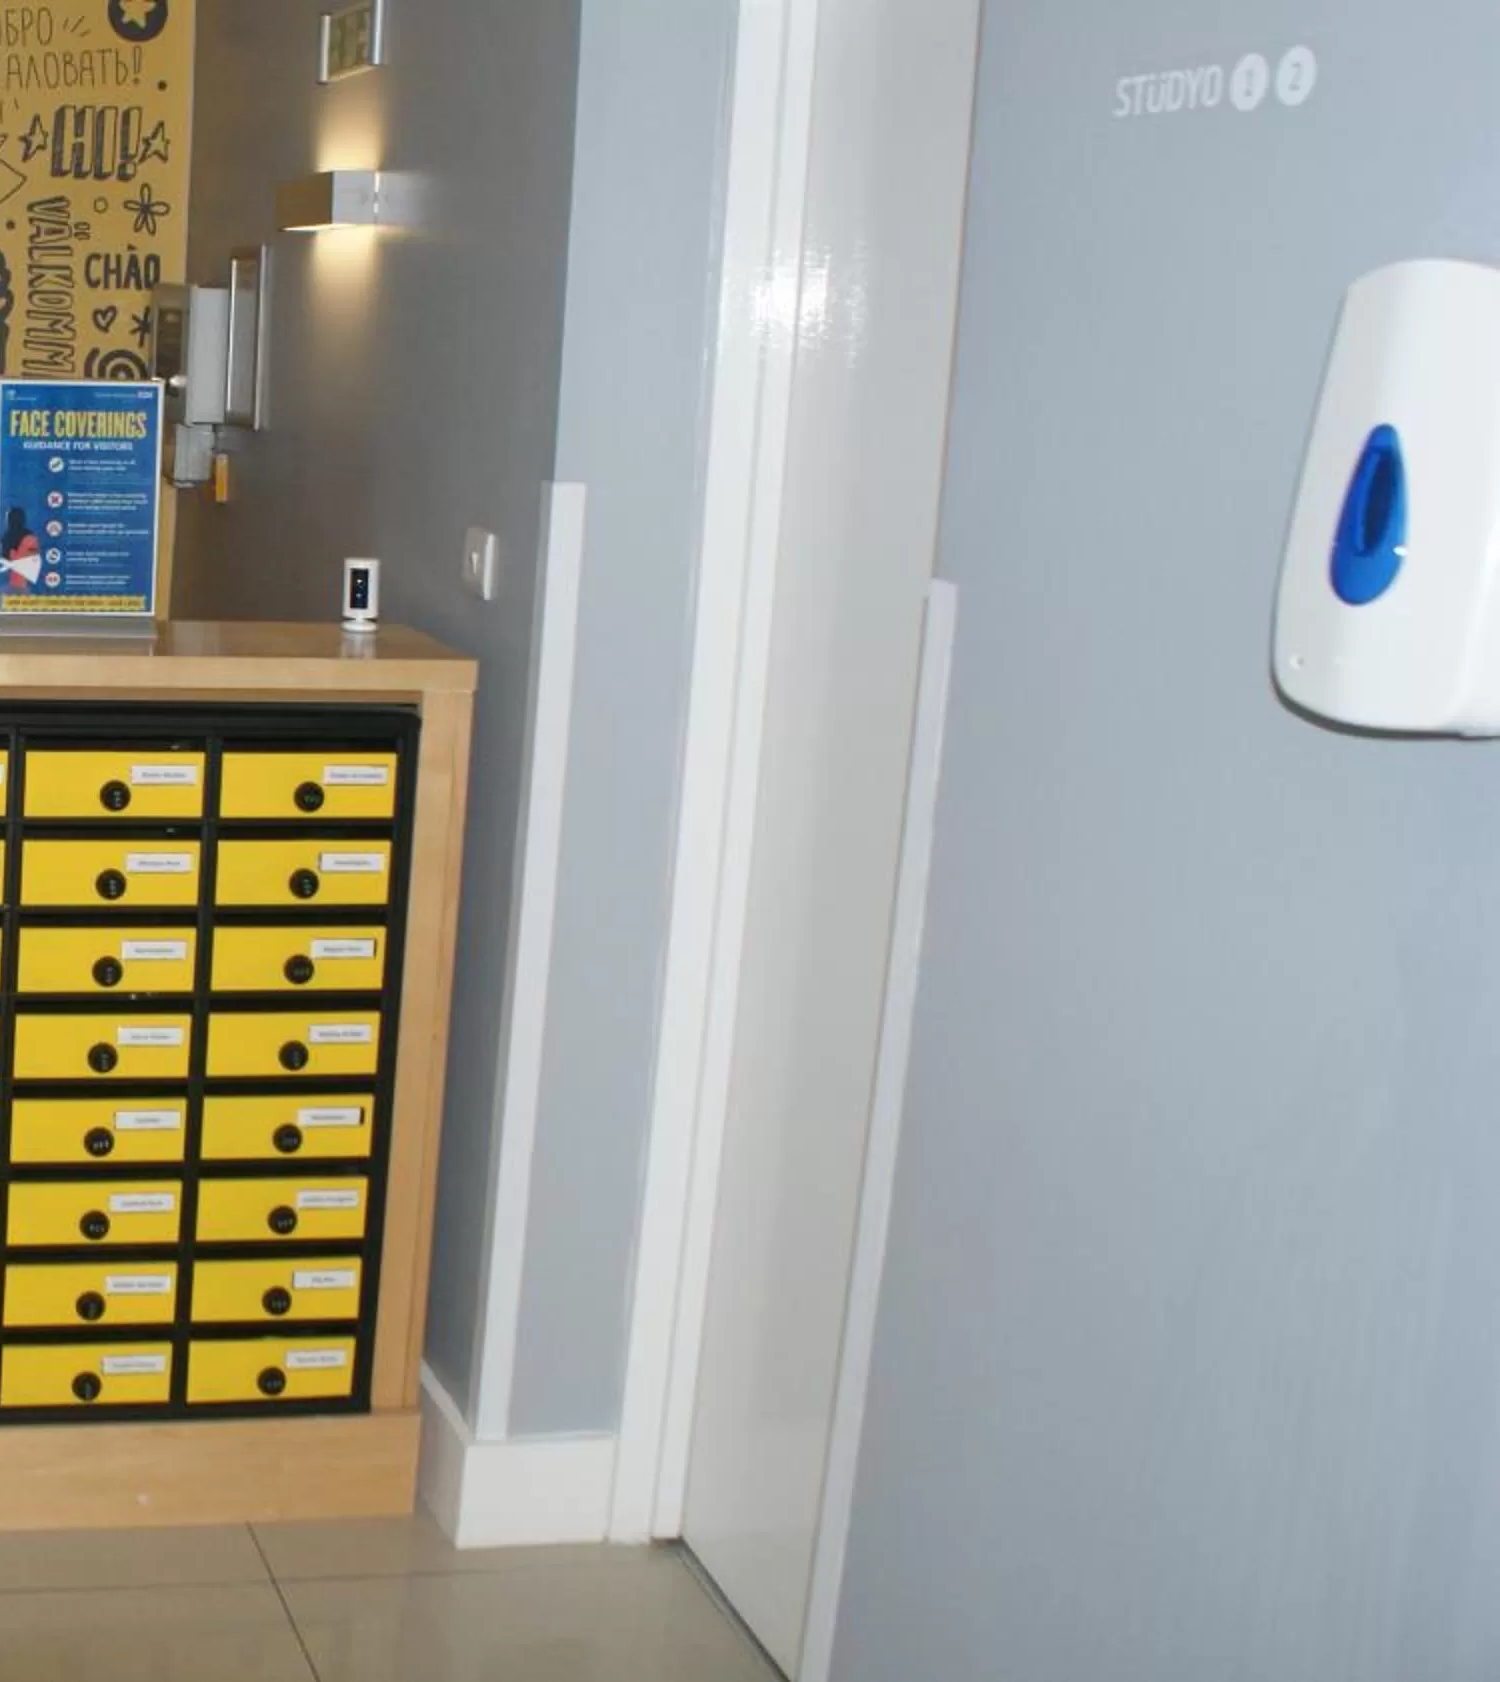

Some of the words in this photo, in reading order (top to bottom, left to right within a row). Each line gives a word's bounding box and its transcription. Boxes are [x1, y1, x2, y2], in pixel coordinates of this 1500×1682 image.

[50, 103, 144, 181] HI!
[21, 195, 91, 378] VÄLKOMM
[10, 409, 49, 437] FACE
[53, 409, 148, 439] COVERINGS
